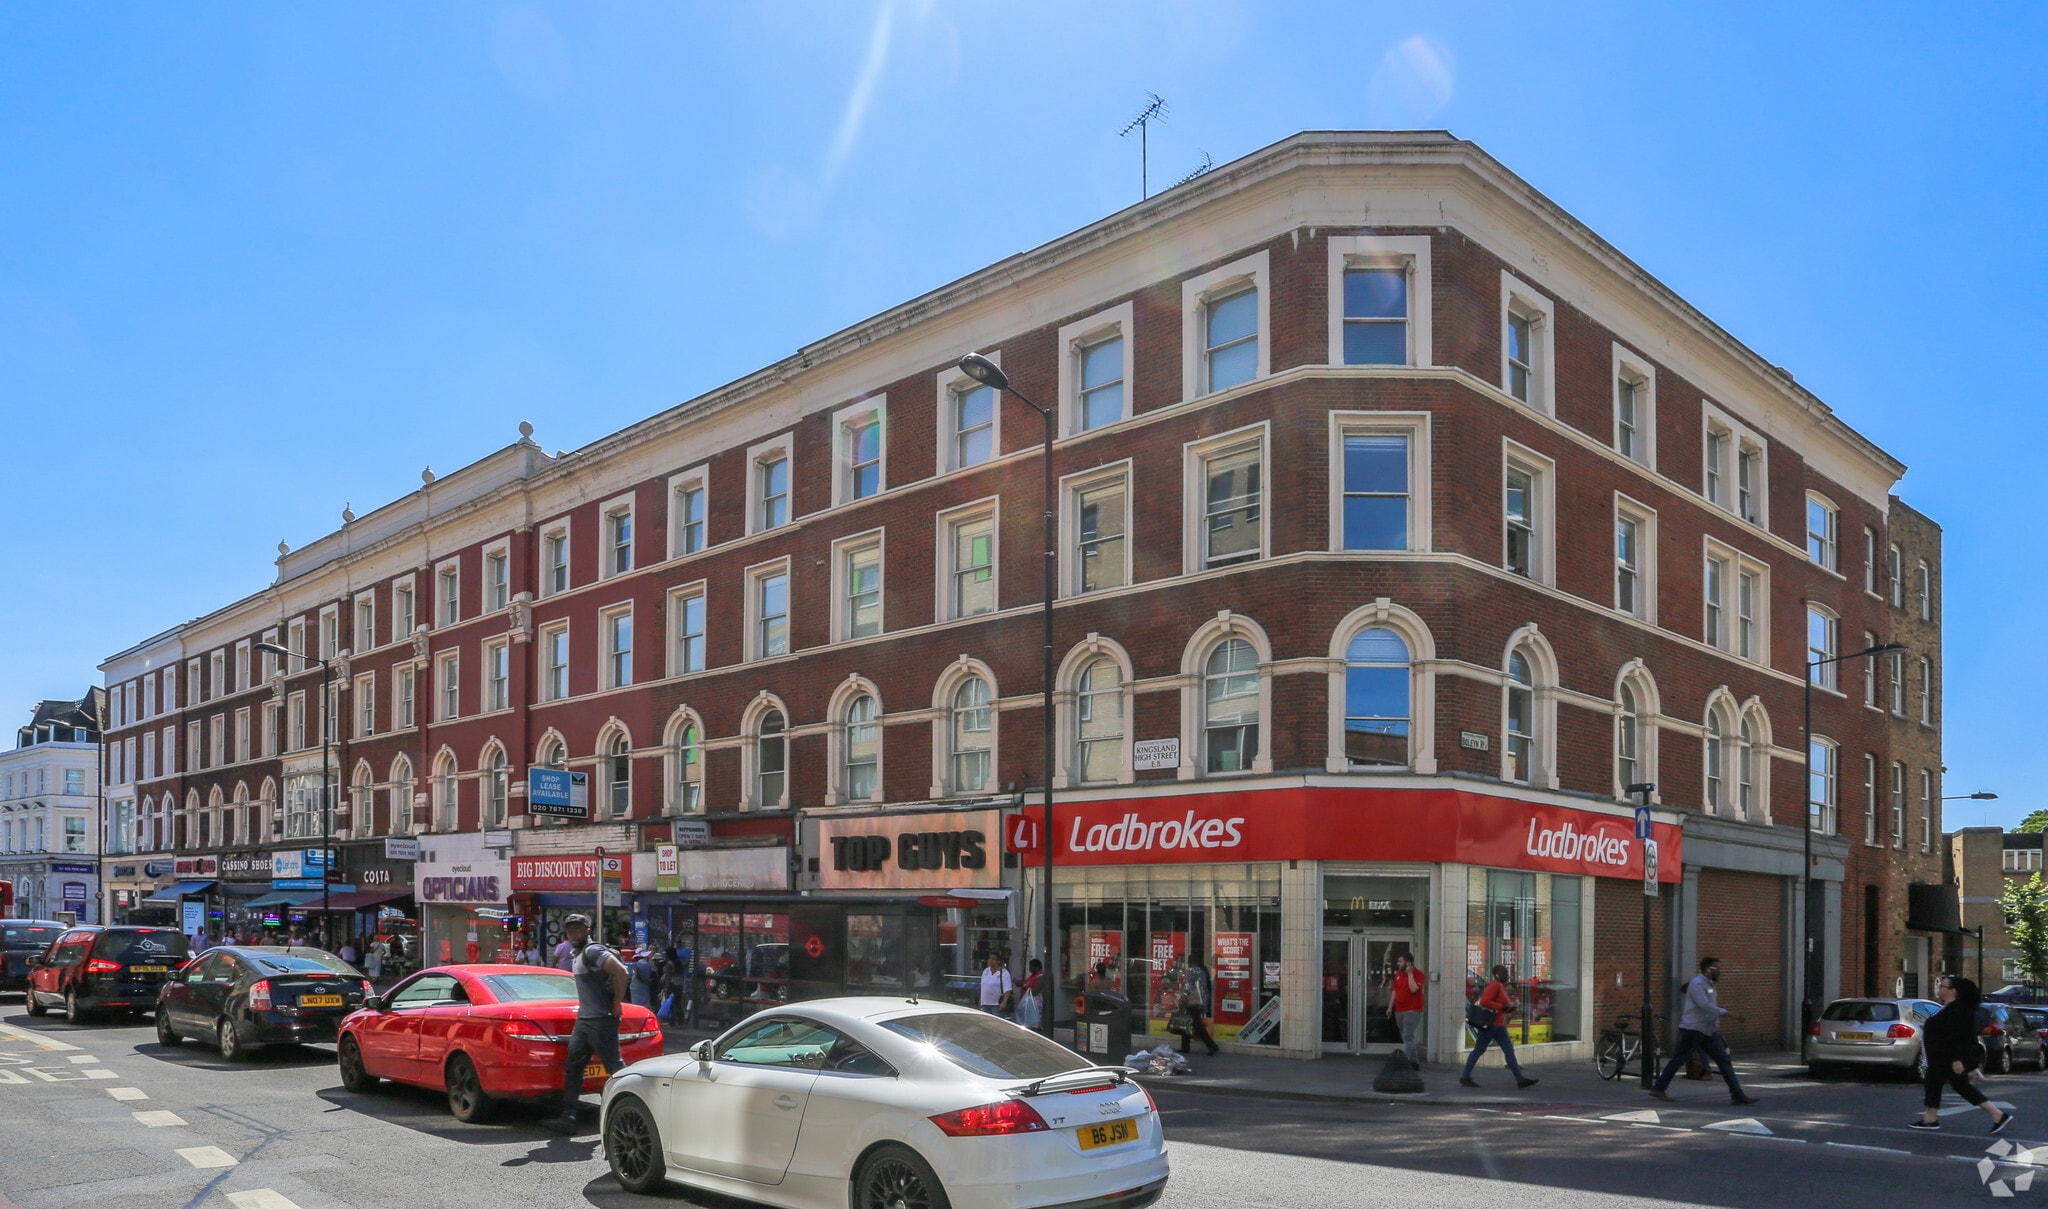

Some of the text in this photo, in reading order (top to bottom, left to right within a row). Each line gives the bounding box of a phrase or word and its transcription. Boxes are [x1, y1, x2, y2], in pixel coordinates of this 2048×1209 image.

[1137, 745, 1177, 754] KINGSLAND
[1135, 752, 1178, 762] HIGH STREET
[533, 790, 569, 798] AVAILABLE
[1069, 810, 1245, 852] Ladbrokes
[1527, 817, 1630, 866] Ladbrokes
[661, 849, 673, 857] SHOP
[830, 830, 987, 871] TOP GUYS
[222, 860, 272, 870] CASSINO SHOES
[452, 864, 472, 874] eyecloud
[517, 862, 533, 877] BIG
[534, 860, 581, 877] DISCOUNT
[660, 861, 676, 871] TO LET
[363, 870, 390, 884] COSTA
[423, 875, 500, 902] OPTICIANS
[1217, 938, 1249, 946] WHAT'S THE
[1091, 943, 1110, 957] FREE
[1152, 945, 1173, 958] FREE
[1223, 946, 1244, 955] SCORE?
[1467, 950, 1482, 965] FREE
[1501, 950, 1515, 965] FREE
[1531, 951, 1546, 965] FREE
[1152, 958, 1167, 971] BET
[302, 996, 340, 1004] LN07 UXW
[1052, 1116, 1066, 1125] TT
[1091, 1123, 1129, 1145] B6 JSN
